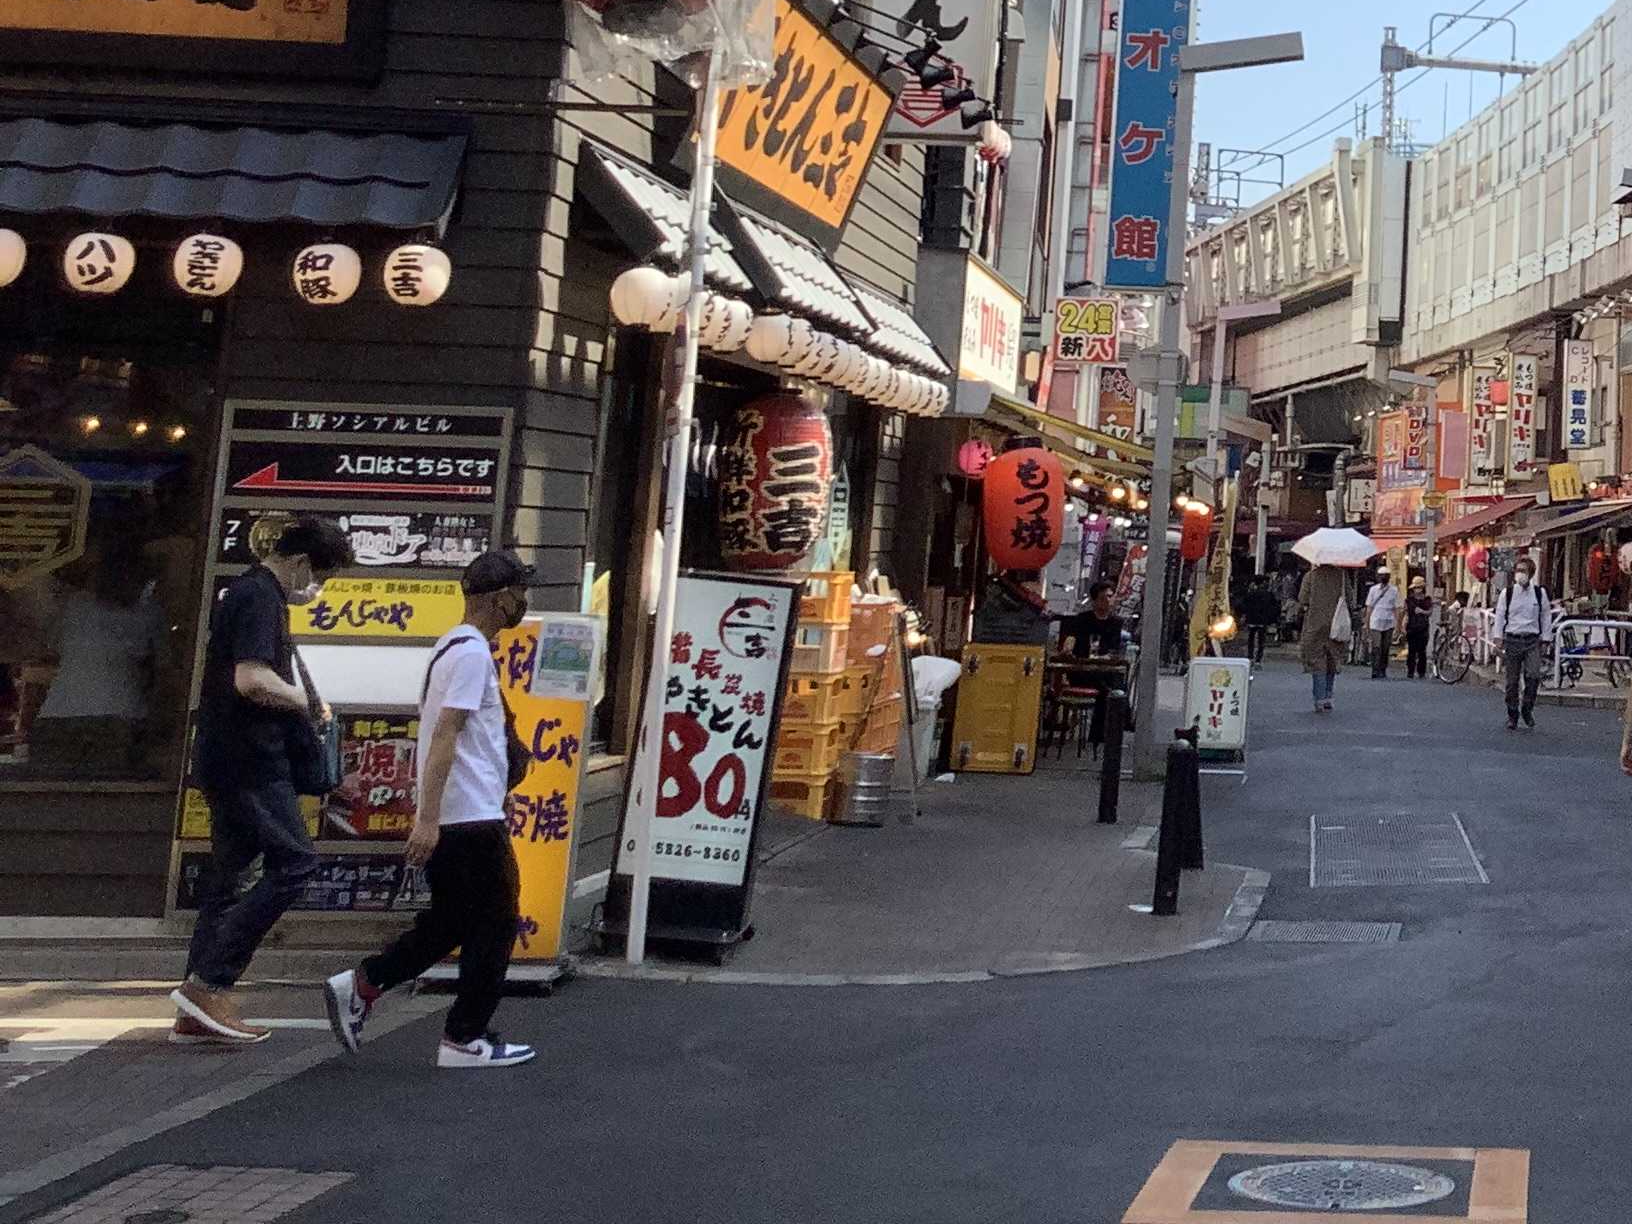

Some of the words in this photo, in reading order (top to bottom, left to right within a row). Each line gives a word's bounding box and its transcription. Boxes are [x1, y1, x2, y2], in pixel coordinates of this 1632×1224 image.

[75, 238, 116, 287] ハツ
[298, 251, 338, 301] 和豚
[391, 250, 425, 299] 三吉
[1060, 336, 1112, 360] 新八
[1580, 346, 1590, 384] レコード
[290, 411, 453, 433] 上野ソシアルビル
[1408, 419, 1421, 457] DVD
[335, 454, 495, 477] 入口はこちらです
[760, 442, 822, 554] 三吉
[1010, 457, 1051, 551] もつ焼
[222, 519, 241, 552] 7F
[321, 582, 456, 596] んじゃ焼・鉄板焼のお店
[308, 599, 414, 631] もんじゃや
[532, 718, 579, 768] じゃ
